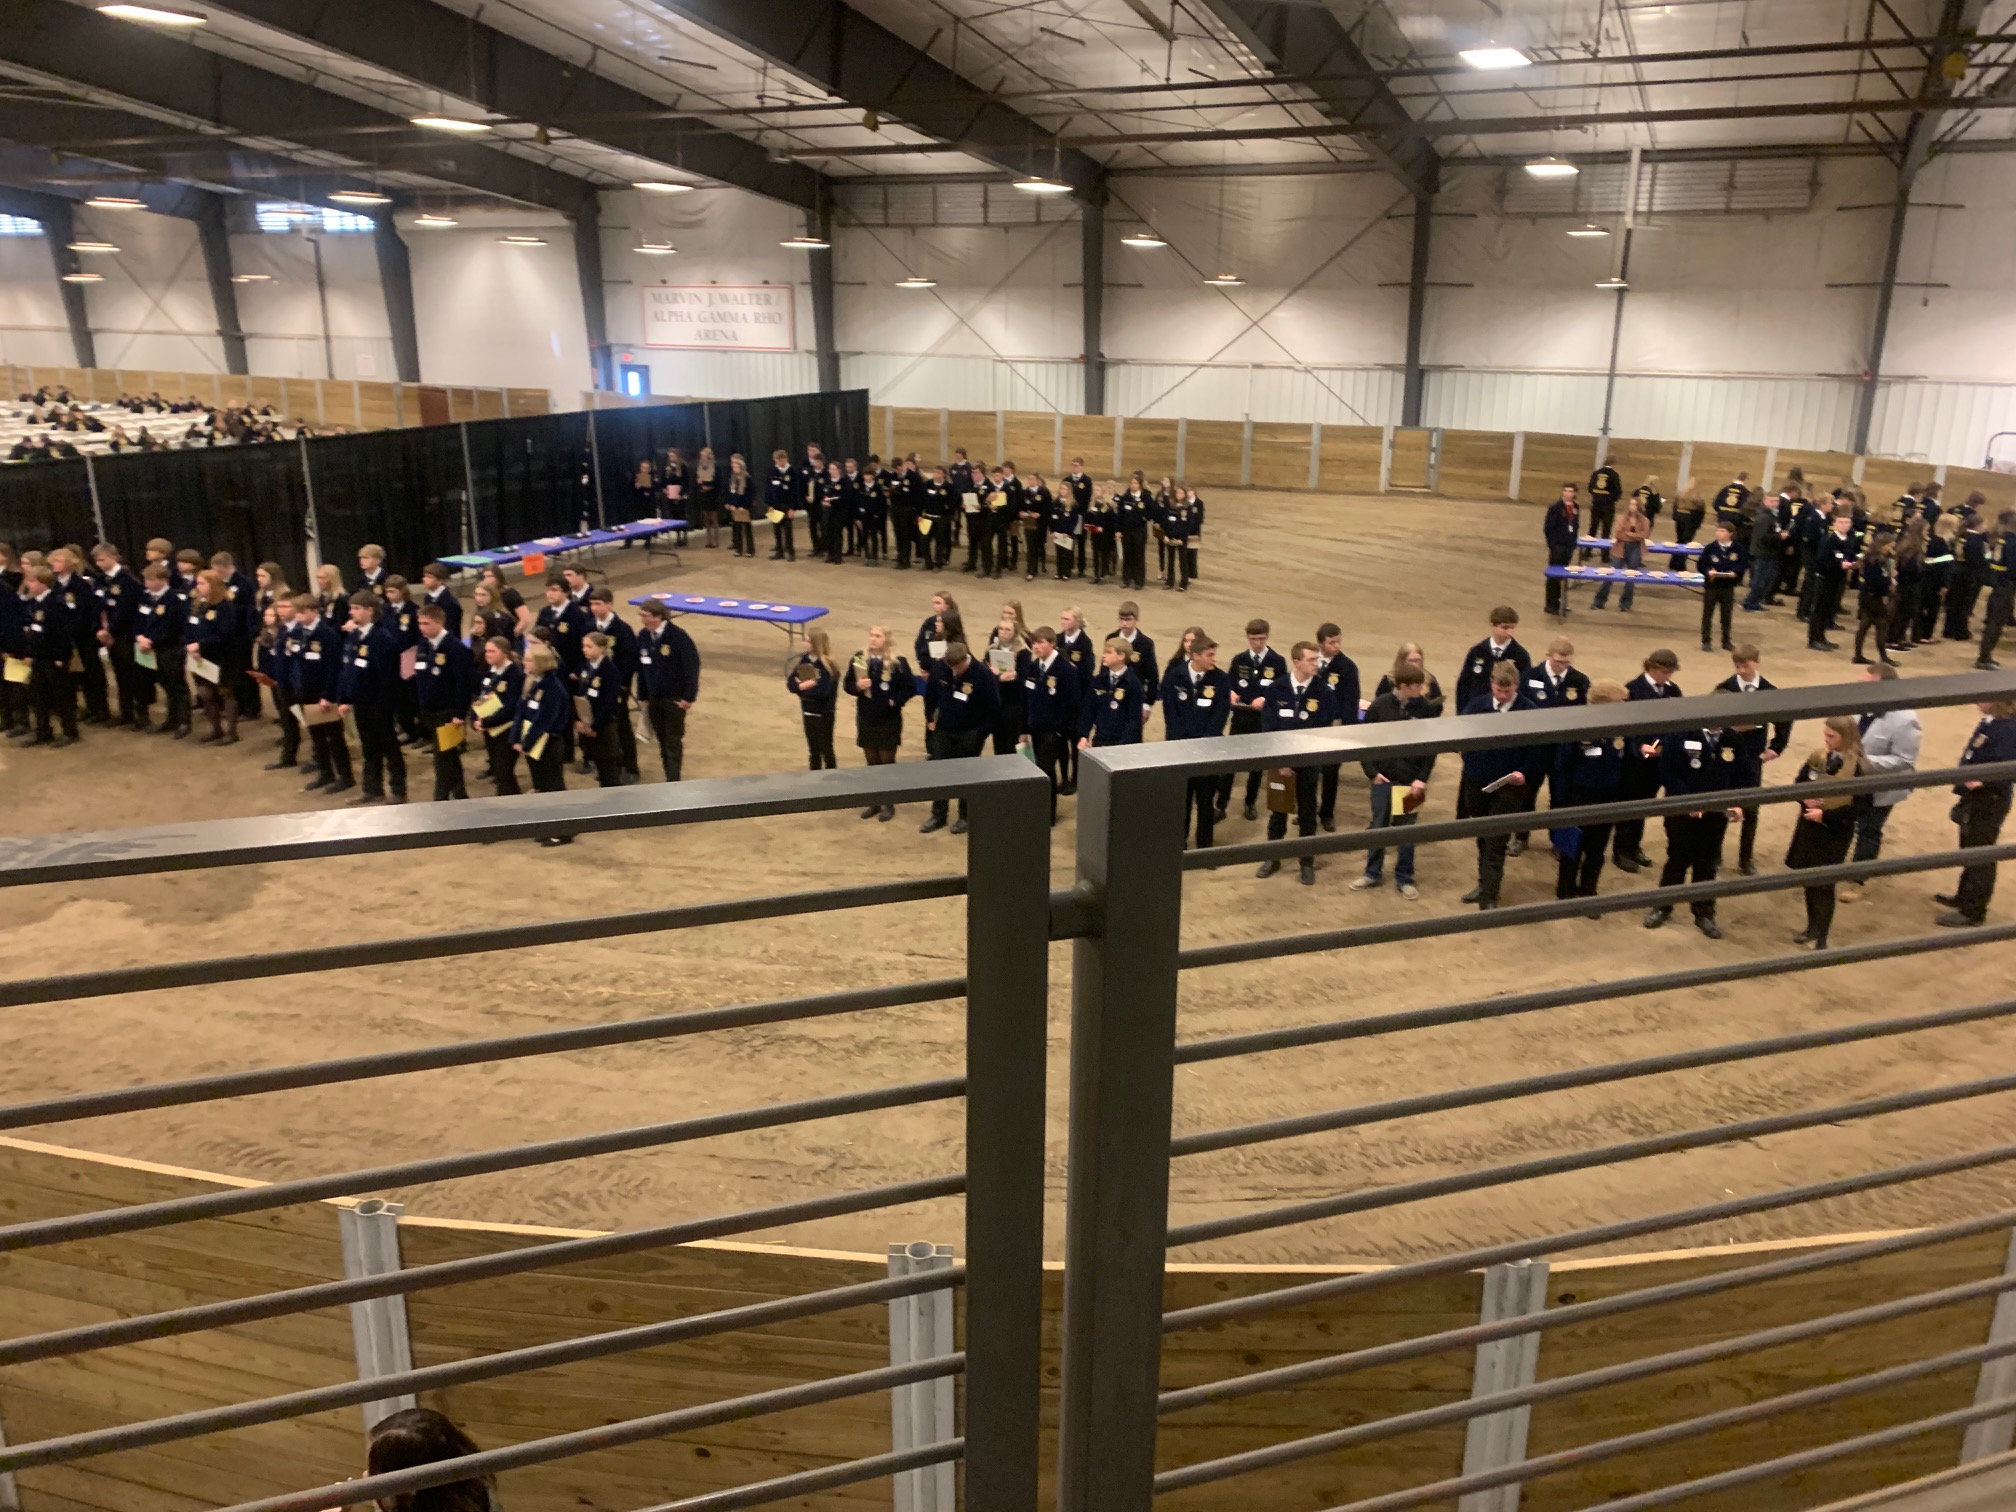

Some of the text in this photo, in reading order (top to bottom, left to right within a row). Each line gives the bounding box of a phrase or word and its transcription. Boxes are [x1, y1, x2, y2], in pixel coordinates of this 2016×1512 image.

[651, 292, 703, 305] MARVIN
[718, 293, 772, 306] WALTER
[653, 310, 782, 325] ALPHA GAMMA RHO
[695, 329, 738, 342] ARENA
